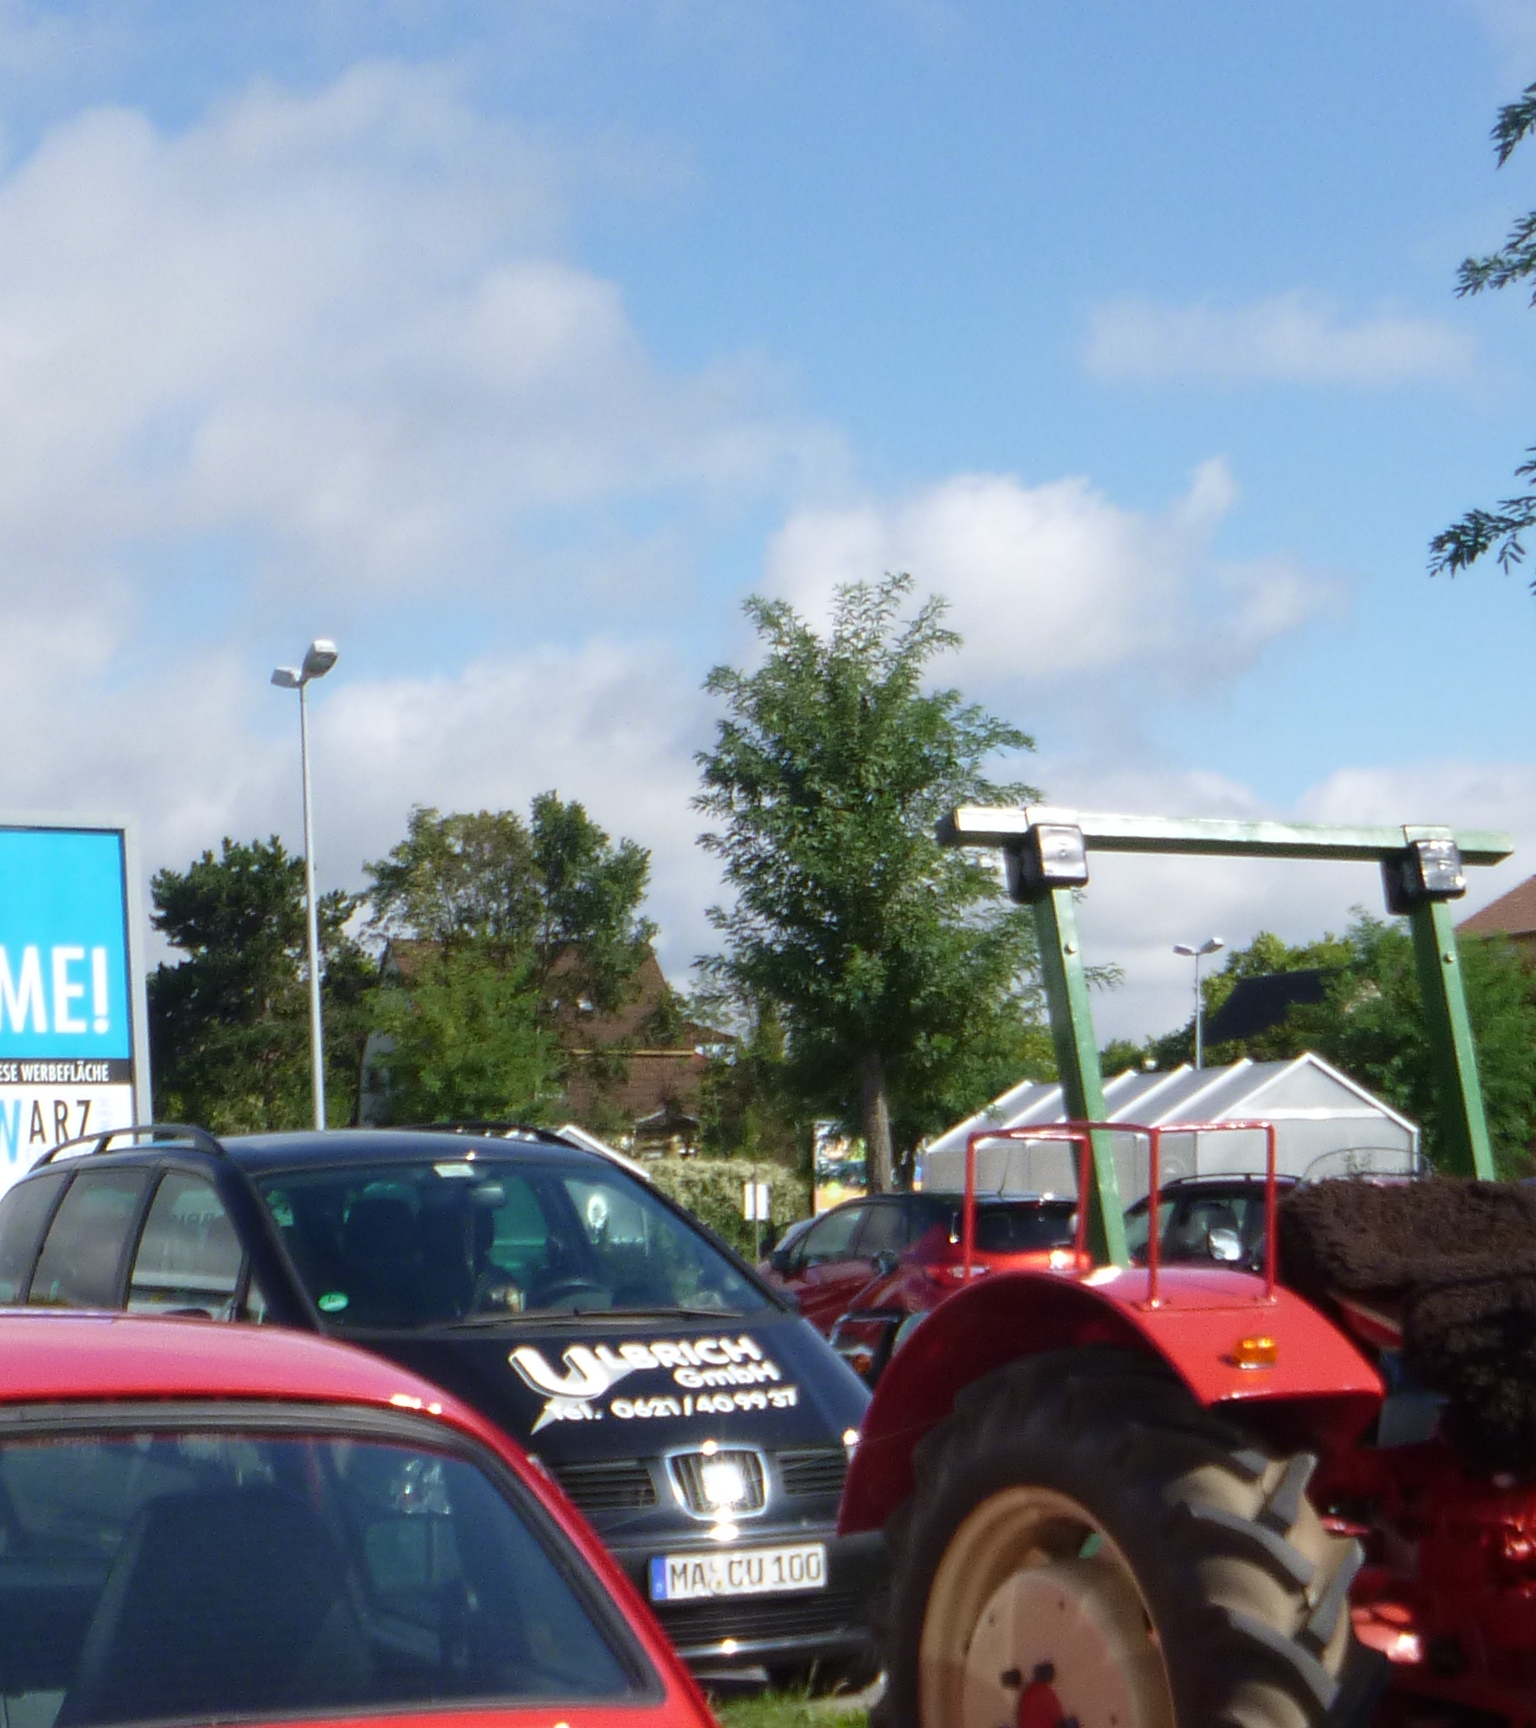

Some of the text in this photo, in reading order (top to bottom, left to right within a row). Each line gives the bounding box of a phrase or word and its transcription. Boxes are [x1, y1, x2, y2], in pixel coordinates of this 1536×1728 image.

[21, 1060, 110, 1082] WERBEFLÄCHE
[508, 1335, 763, 1400] ULBRICH
[669, 1561, 708, 1593] MA
[772, 1551, 822, 1585] 100
